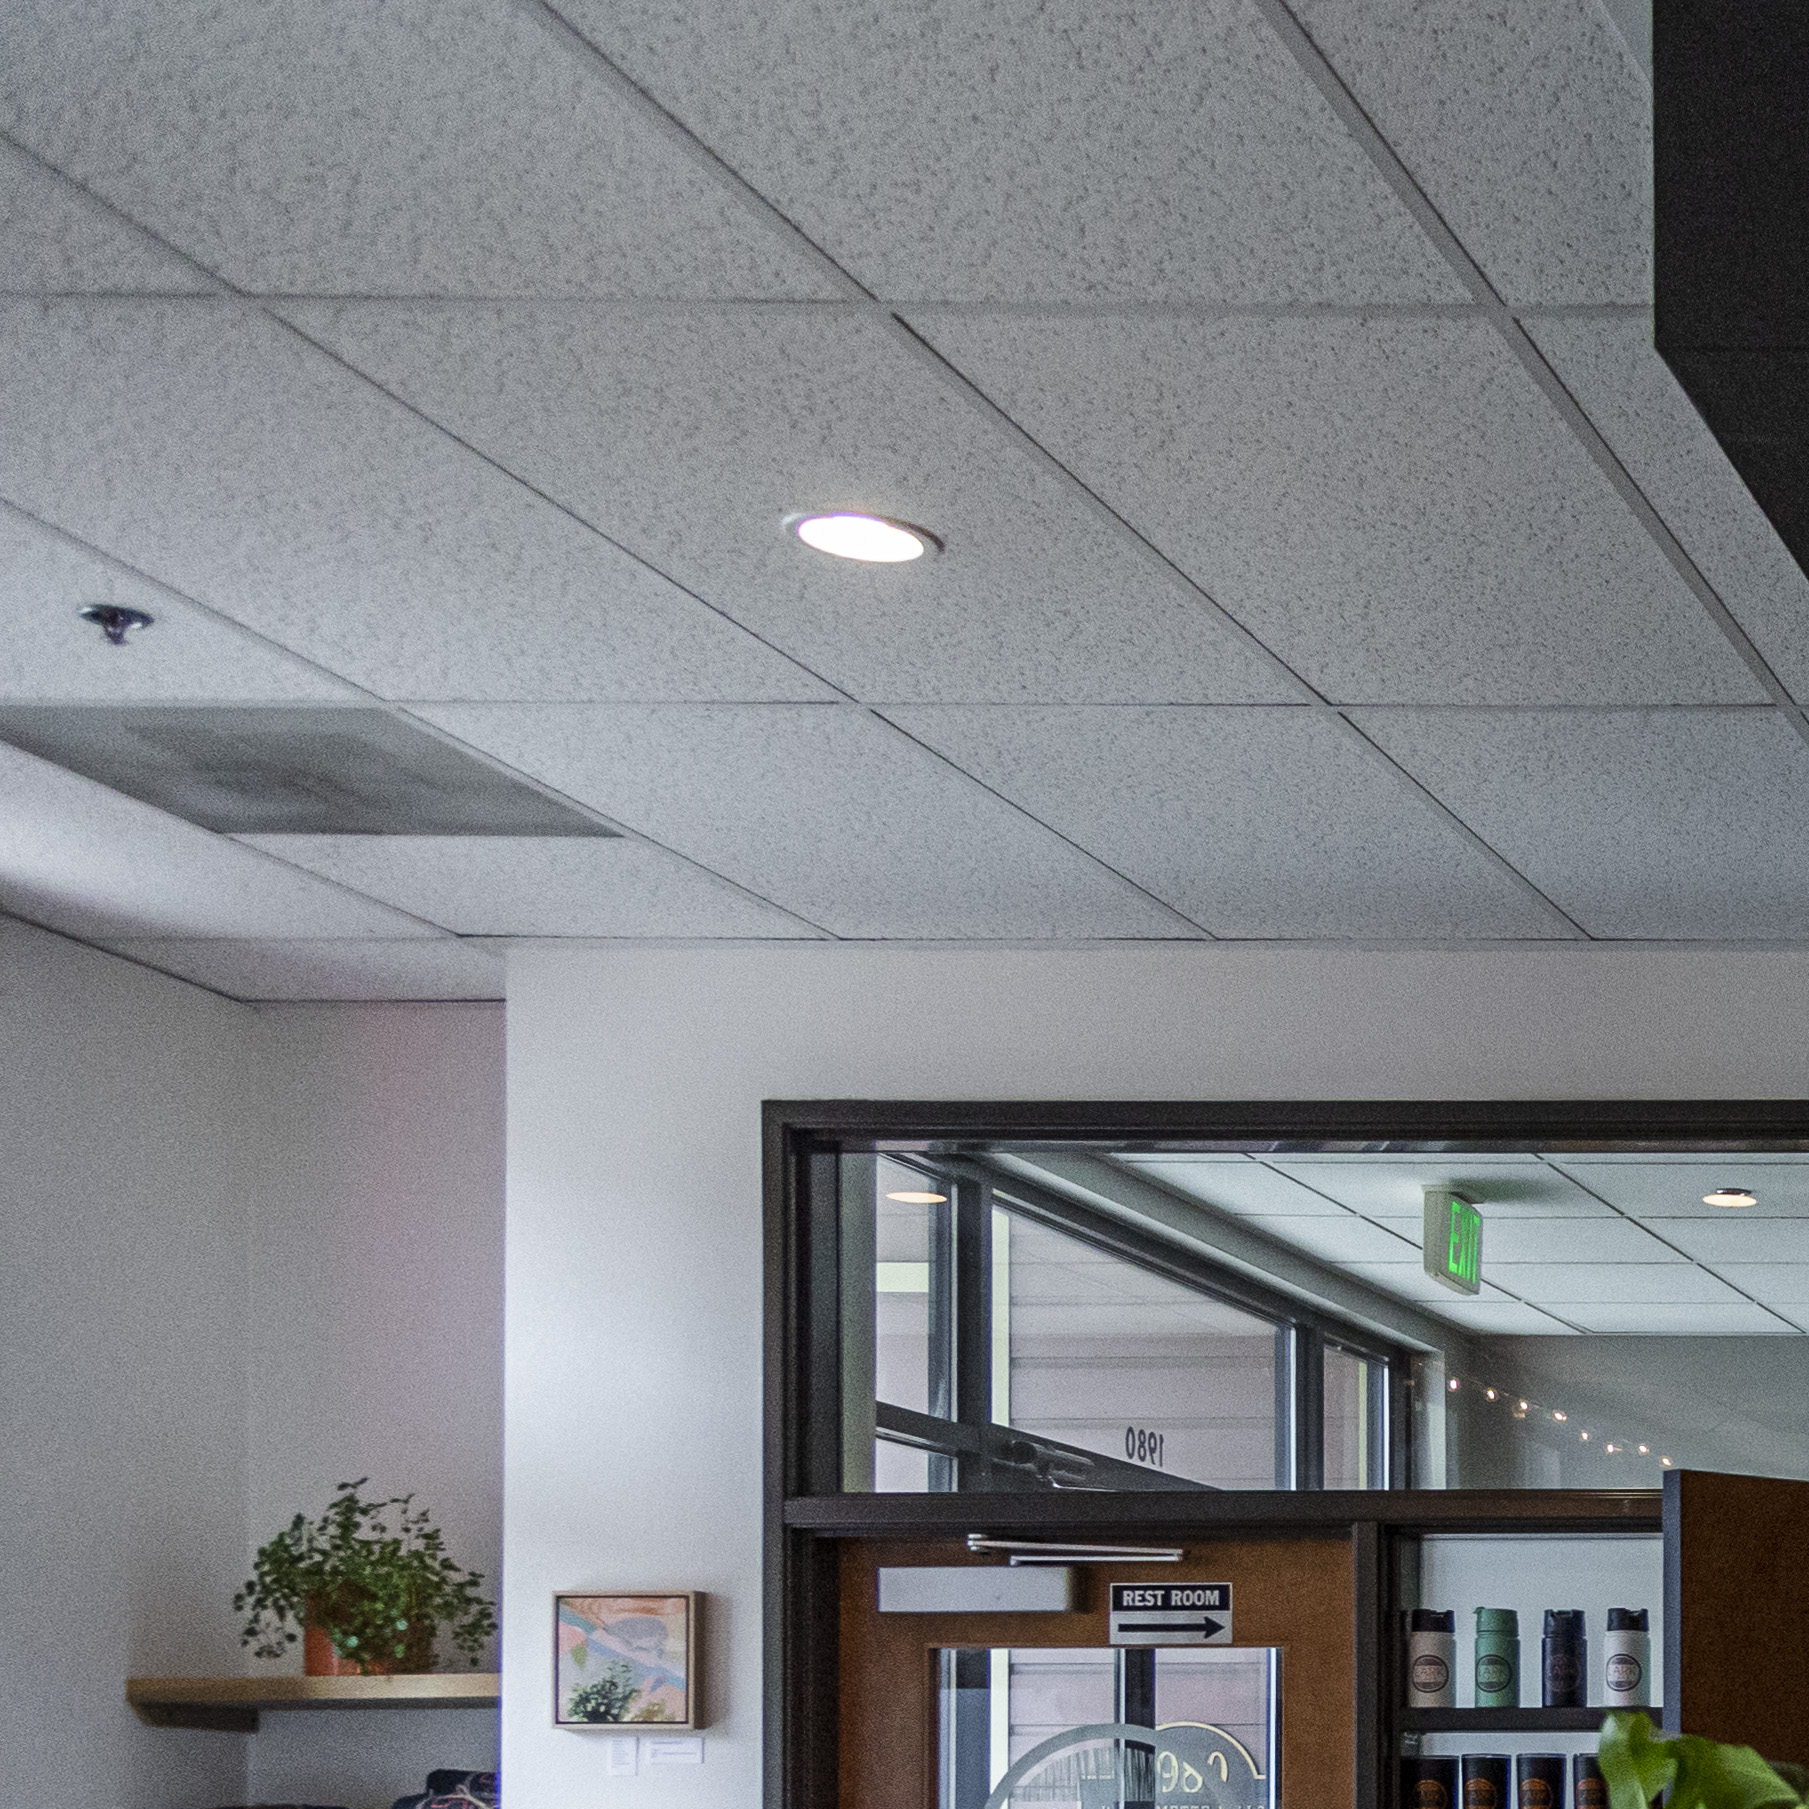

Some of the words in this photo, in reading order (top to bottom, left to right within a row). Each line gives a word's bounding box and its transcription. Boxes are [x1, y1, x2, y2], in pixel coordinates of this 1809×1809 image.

[1448, 1201, 1480, 1283] EXIT
[1123, 1590, 1165, 1606] REST
[1171, 1590, 1220, 1606] ROOM
